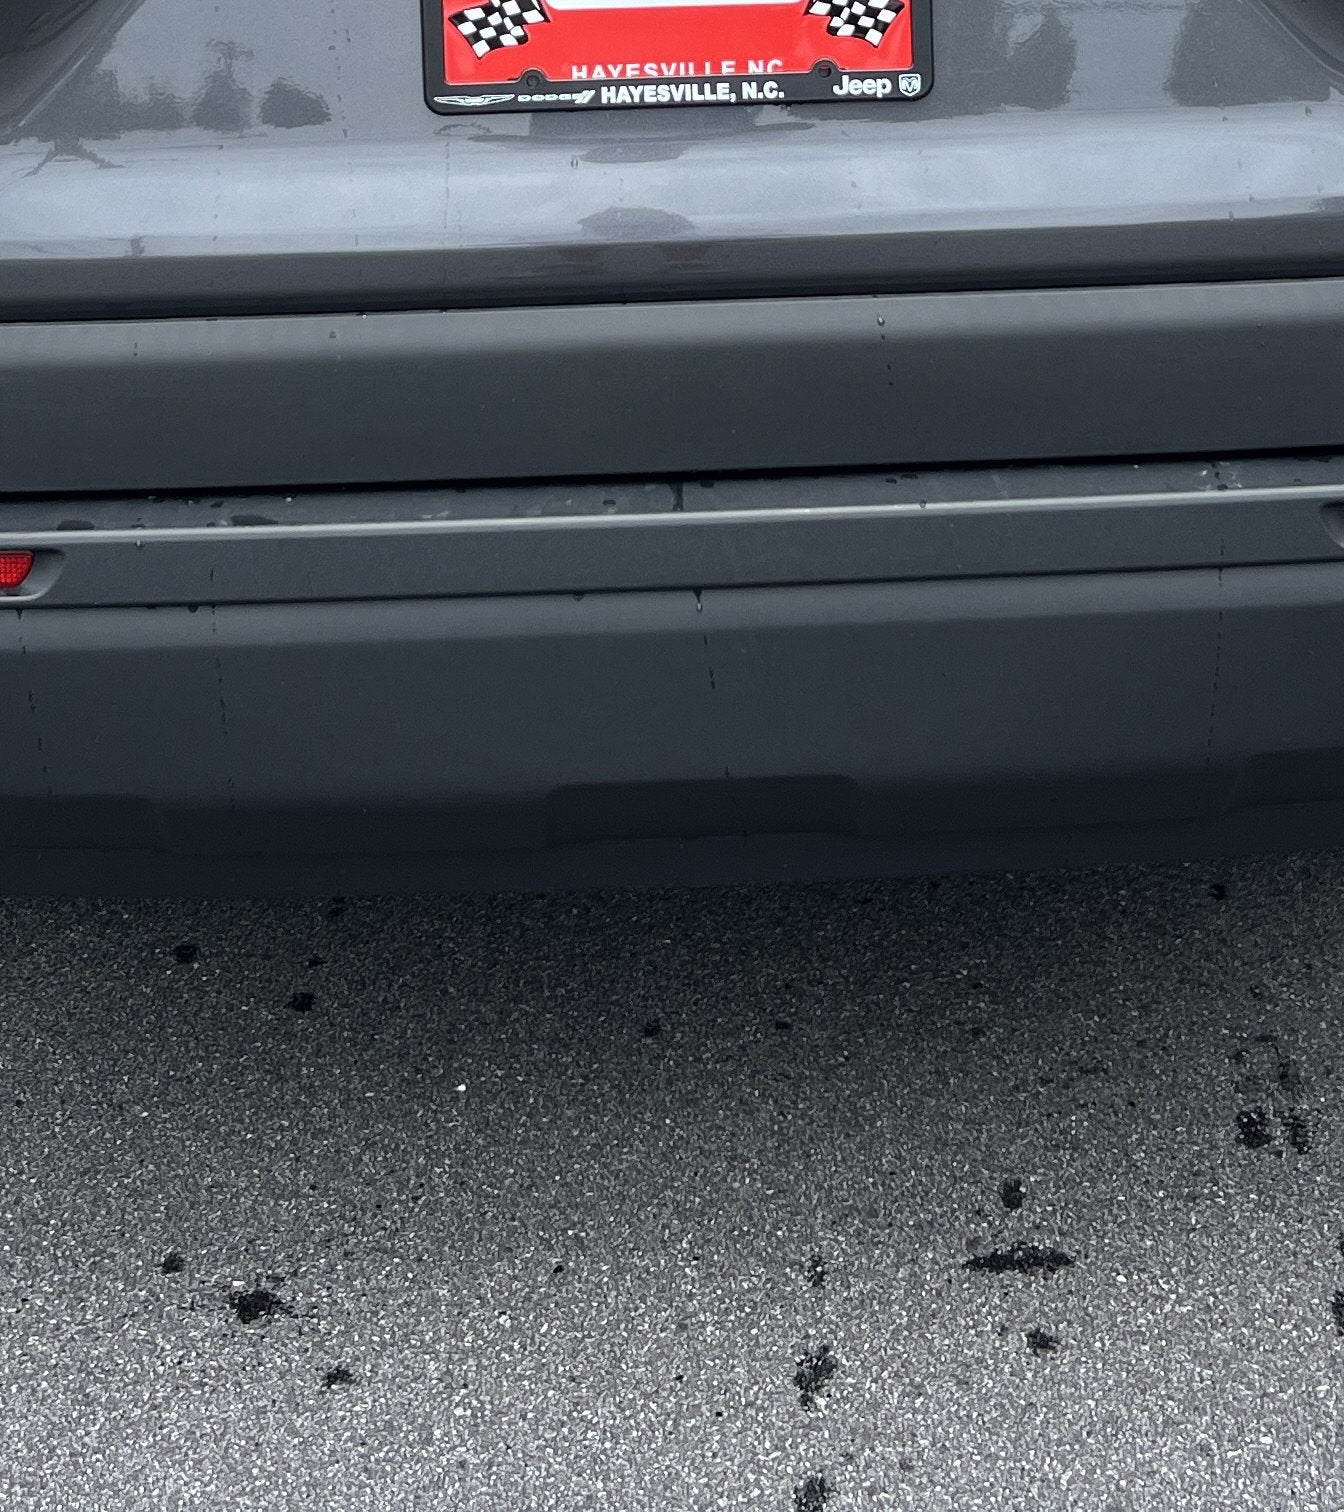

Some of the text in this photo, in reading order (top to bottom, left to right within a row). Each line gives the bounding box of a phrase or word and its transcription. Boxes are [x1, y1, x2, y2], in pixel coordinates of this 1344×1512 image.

[600, 80, 785, 104] HAYESVILLE, N.C.
[832, 74, 892, 98] Jeep
